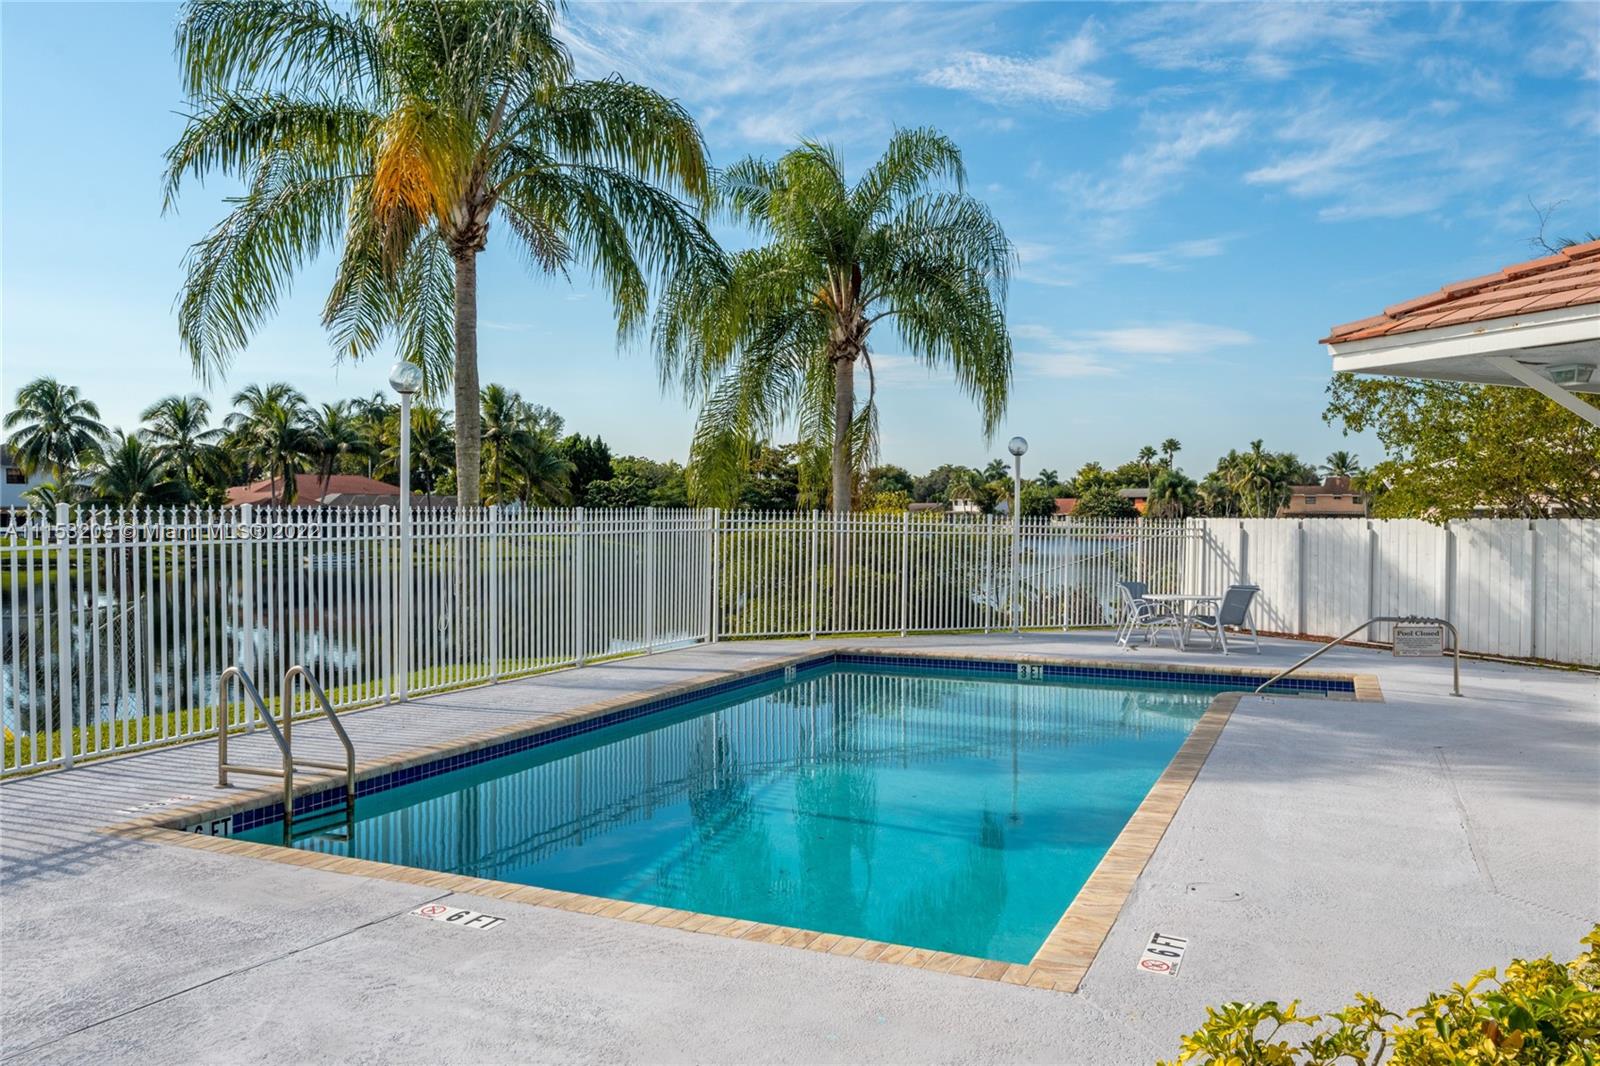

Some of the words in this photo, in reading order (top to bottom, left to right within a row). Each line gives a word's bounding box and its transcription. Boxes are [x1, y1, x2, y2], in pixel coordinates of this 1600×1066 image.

[211, 817, 232, 837] FT
[446, 910, 471, 922] 6
[463, 914, 507, 929] FT
[1151, 932, 1187, 950] FT
[1146, 948, 1181, 958] 6
